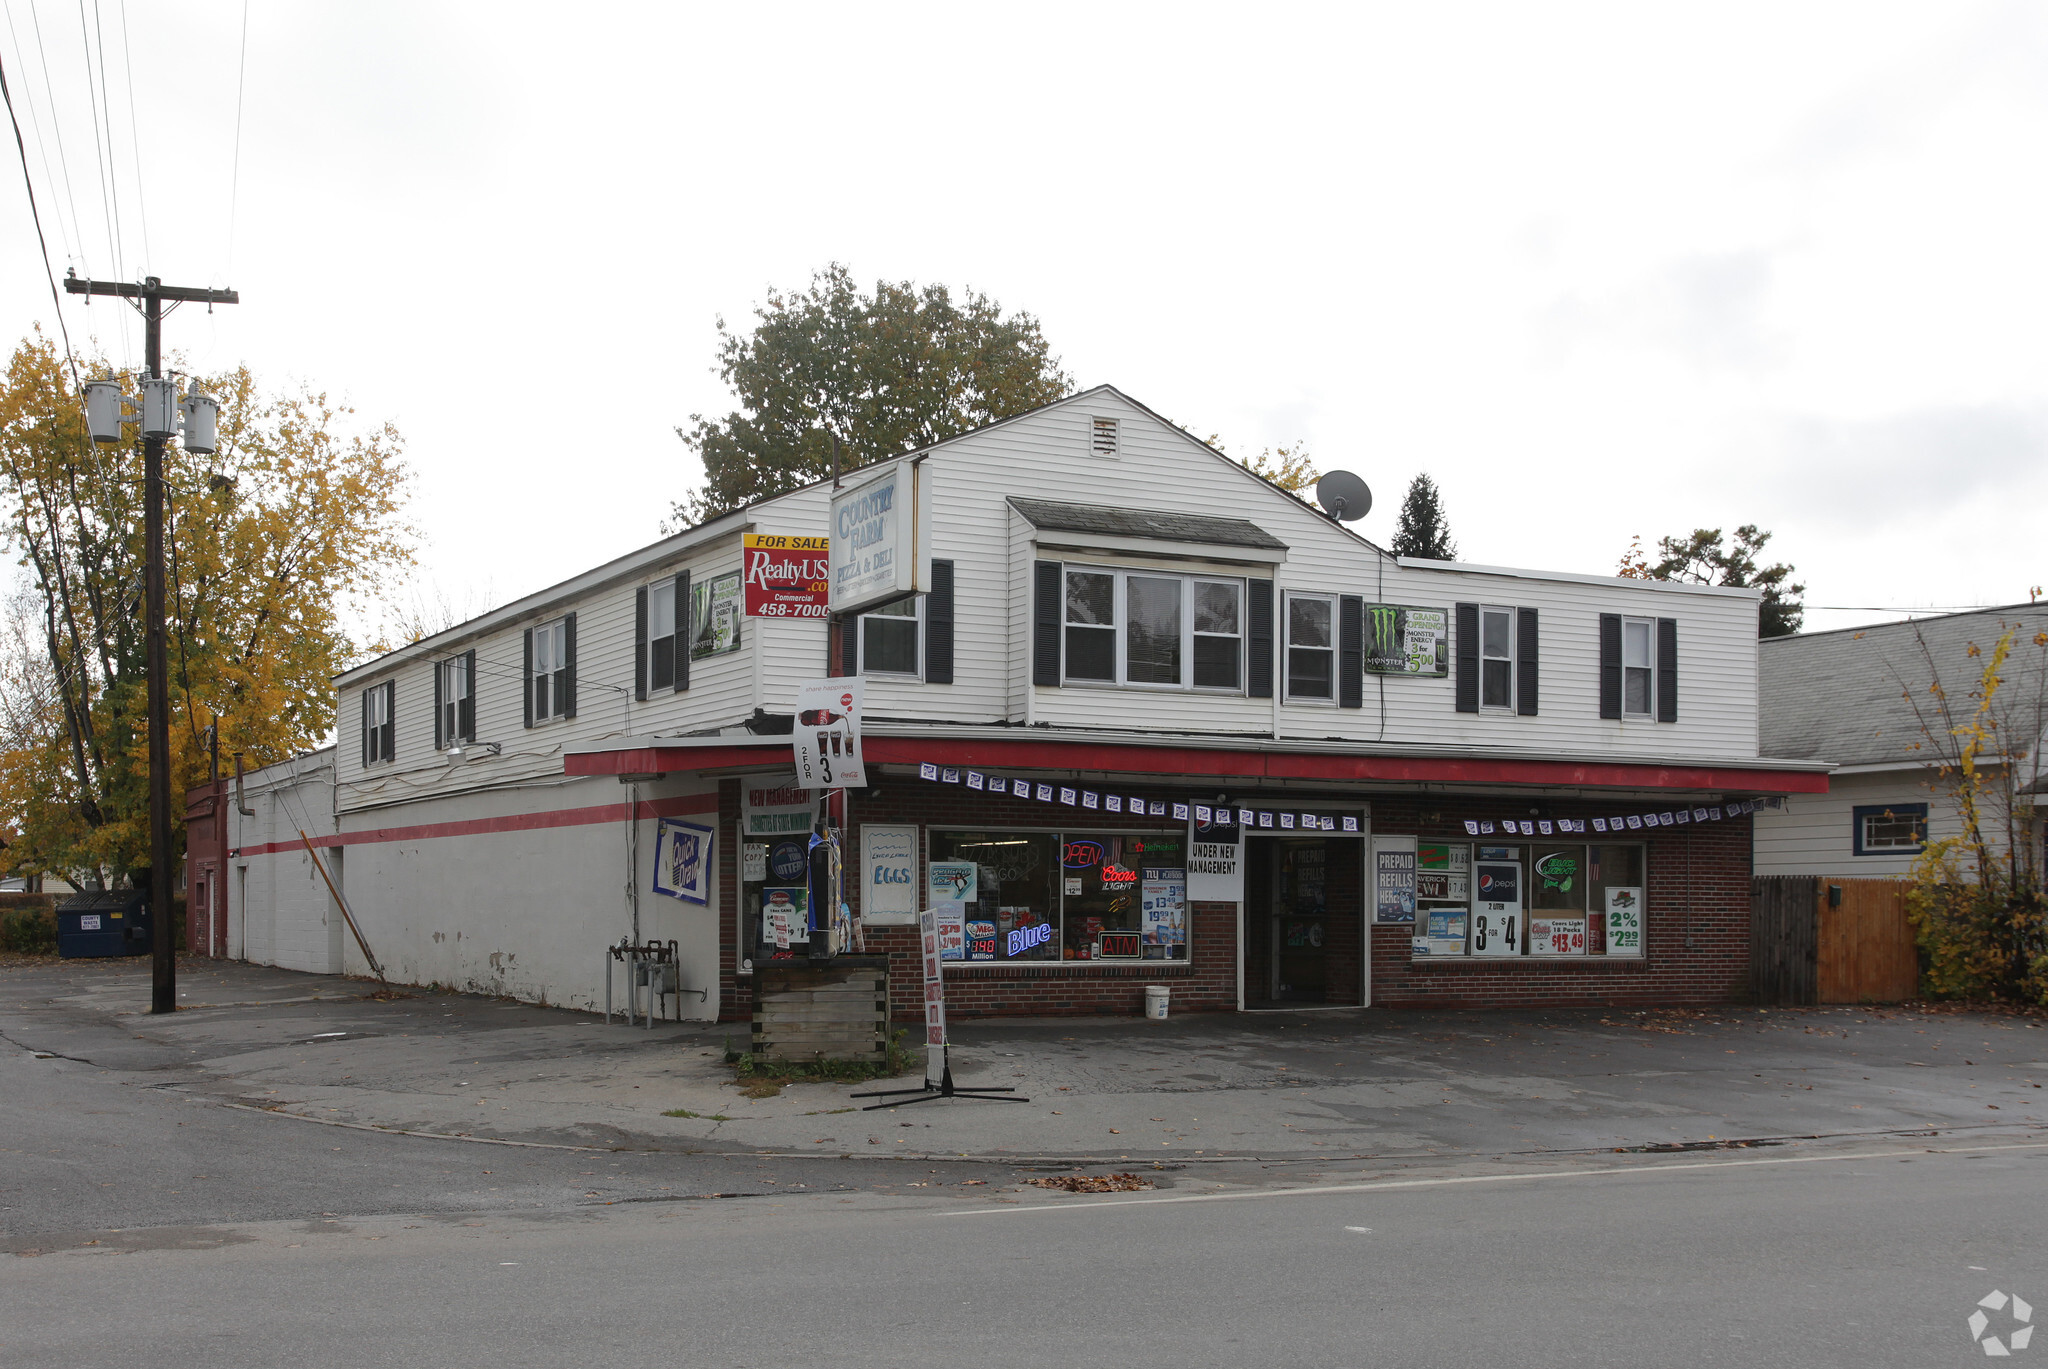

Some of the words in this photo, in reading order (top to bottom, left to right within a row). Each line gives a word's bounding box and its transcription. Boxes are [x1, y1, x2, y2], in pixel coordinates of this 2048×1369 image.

[838, 484, 894, 539] COUNTRY
[756, 536, 786, 547] FOR
[791, 537, 829, 549] SALE
[850, 516, 884, 562] FARM
[746, 551, 829, 590] RealtyUS
[837, 561, 861, 584] PIZZA
[864, 557, 870, 574] &
[873, 548, 892, 570] DELI
[775, 593, 814, 602] Commercial
[758, 603, 828, 617] 458-7000
[1412, 612, 1440, 621] GRAND
[716, 617, 722, 628] 3
[1408, 630, 1435, 638] MONSTER
[1411, 643, 1418, 653] 3
[1367, 657, 1403, 667] MONSTER
[823, 684, 853, 692] happiness
[801, 746, 807, 754] 2
[819, 757, 832, 783] 3
[749, 789, 765, 807] NEW
[766, 787, 810, 806] MANAGEMENT
[673, 835, 695, 867] Quick
[1063, 843, 1100, 864] OPEN
[1144, 843, 1179, 851] Heineken
[1192, 844, 1217, 858] UNDER
[1220, 845, 1235, 858] NEW
[744, 853, 763, 861] COPY
[1380, 855, 1413, 868] PREPAID
[679, 859, 698, 887] Draw
[1102, 865, 1137, 881] Coors
[1188, 860, 1236, 874] MANAGEMENT
[874, 865, 910, 884] EGGS
[1380, 873, 1413, 887] REFILLS
[1102, 882, 1134, 890] LIGHT
[1494, 880, 1516, 888] pepsi
[1610, 912, 1638, 927] 2%
[975, 924, 995, 933] MEGA
[1476, 916, 1487, 950] 3
[1532, 922, 1551, 934] Coors
[1008, 923, 1051, 956] Blue
[1103, 937, 1138, 955] ATM
[1552, 934, 1583, 952] $13.49
